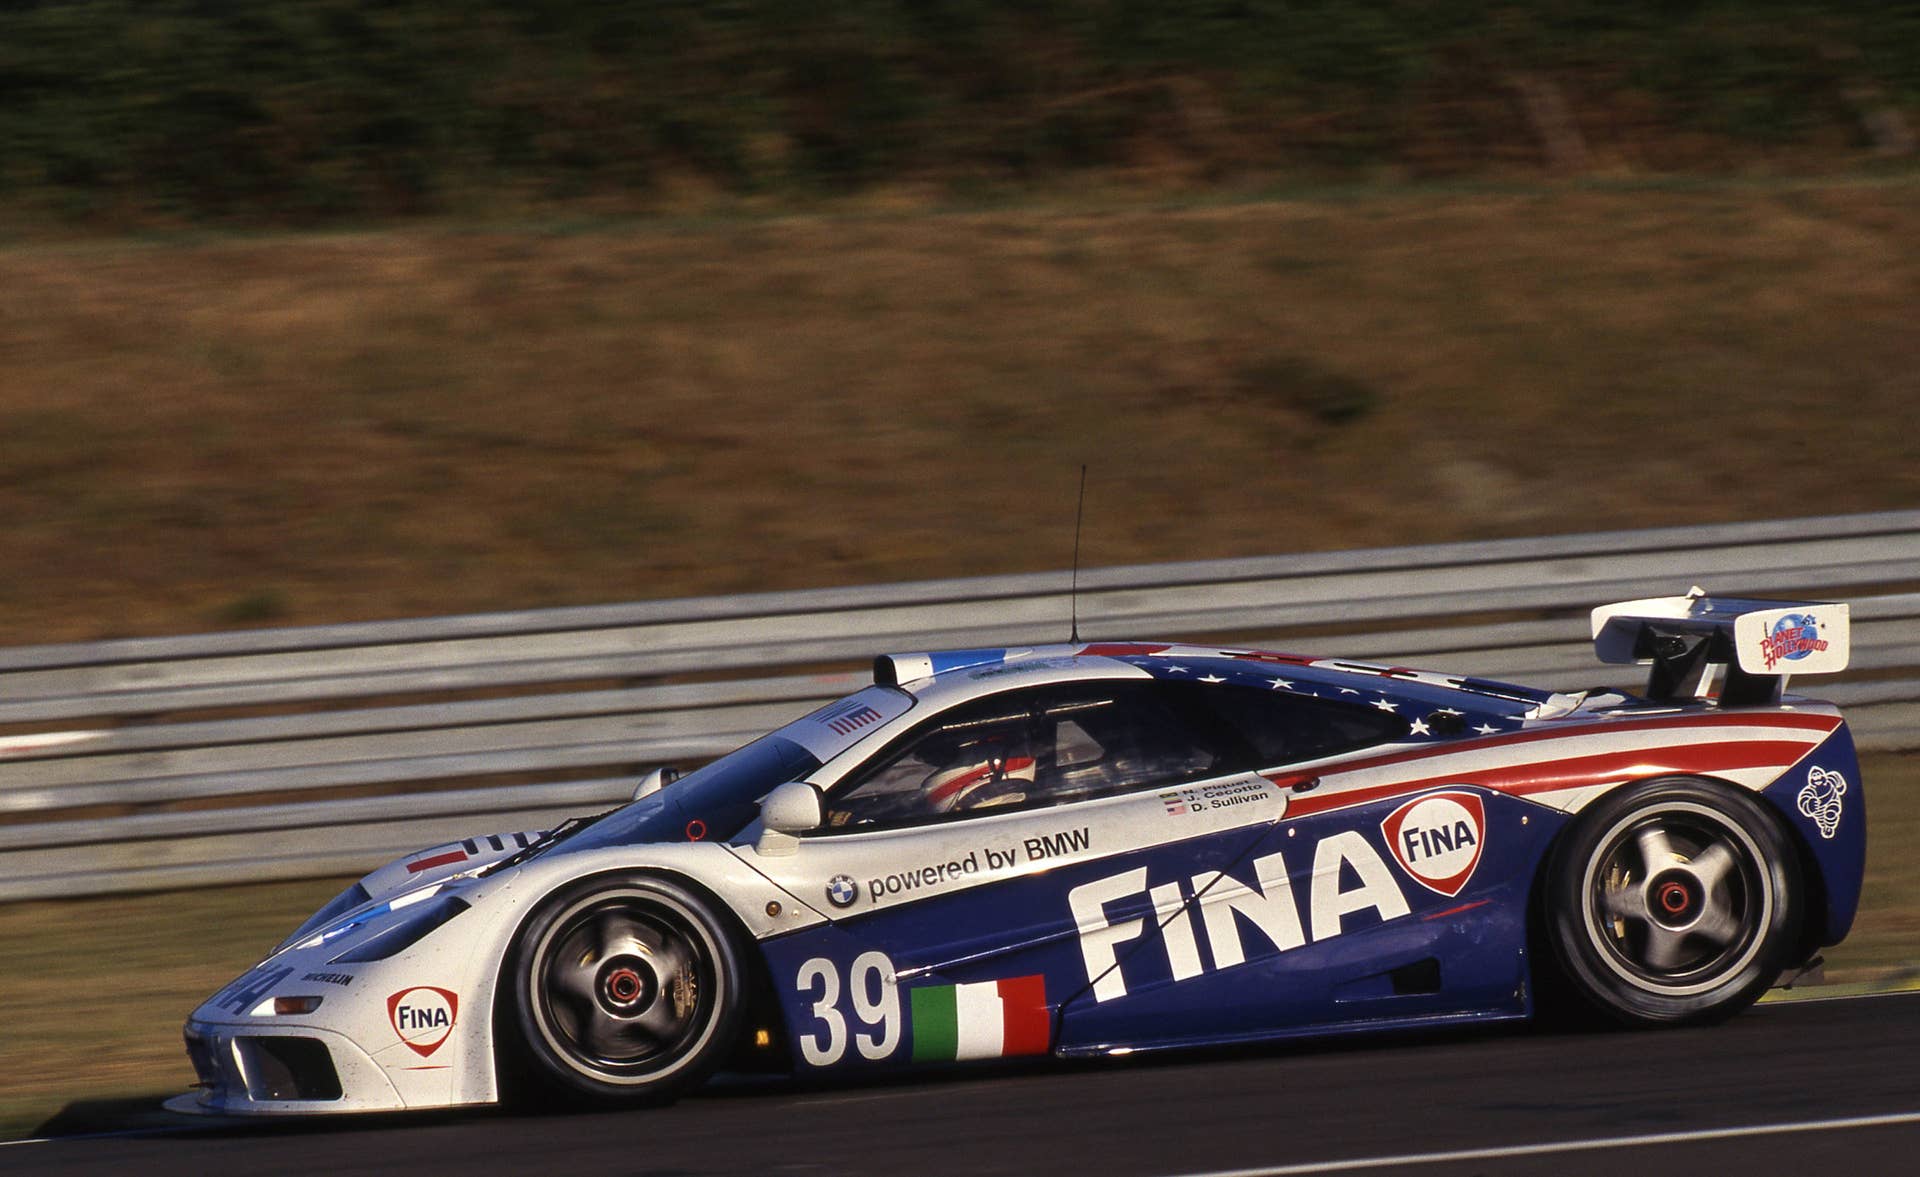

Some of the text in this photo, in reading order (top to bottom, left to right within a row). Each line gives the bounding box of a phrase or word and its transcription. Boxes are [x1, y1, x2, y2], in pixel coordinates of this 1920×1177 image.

[1760, 627, 1805, 659] PLANET
[1764, 637, 1829, 671] HOLLYWOOD
[1190, 791, 1269, 812] D. Sullivan
[1203, 783, 1263, 799] Cecotto
[1403, 820, 1476, 863] FINA
[868, 827, 1090, 903] powered by BMW
[1068, 830, 1412, 1003] FINA
[398, 1005, 449, 1030] FINA
[797, 950, 901, 1067] 39
